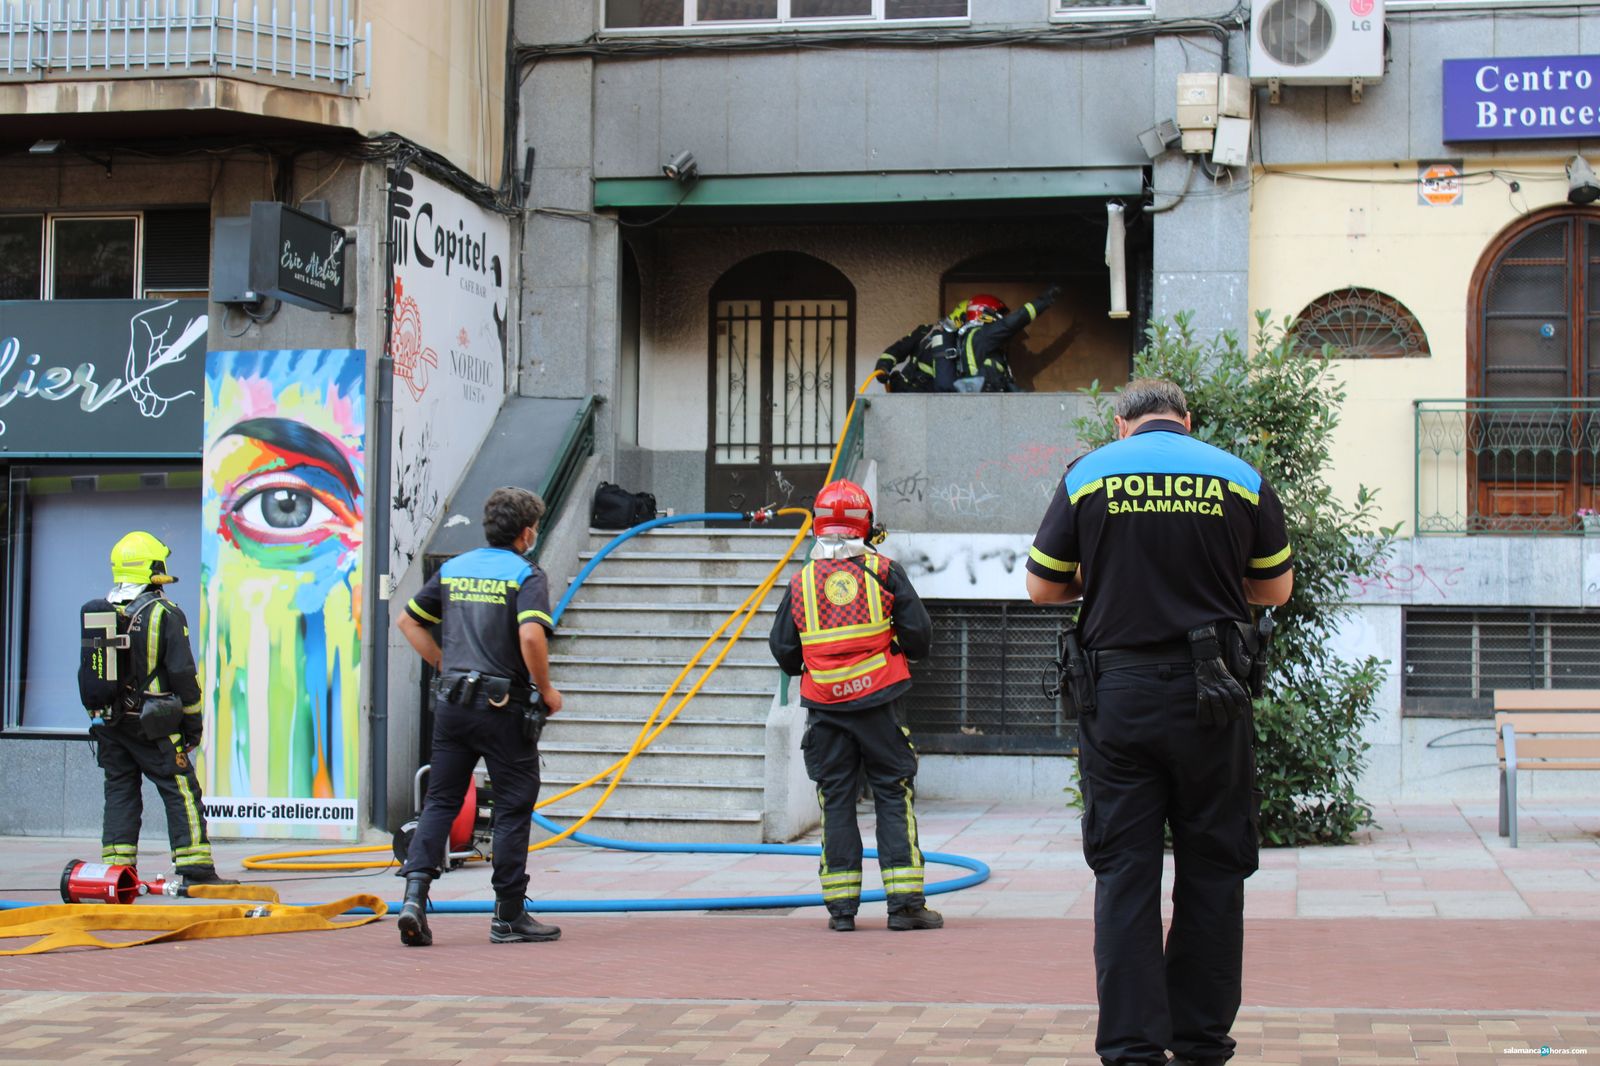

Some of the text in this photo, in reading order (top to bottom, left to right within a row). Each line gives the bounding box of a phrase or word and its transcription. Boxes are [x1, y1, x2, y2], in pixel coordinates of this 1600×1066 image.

[1352, 20, 1372, 31] LG
[1475, 65, 1592, 92] Centro
[1475, 101, 1600, 128] Bronce
[413, 202, 487, 276] Capitel
[281, 240, 341, 287] Eric Atelier
[475, 282, 487, 298] BAR
[449, 350, 494, 388] NORDIC
[1105, 475, 1224, 501] POLICIA
[1108, 499, 1224, 517] SALAMANCA
[449, 577, 507, 595] POLICIA
[832, 675, 872, 697] CABO
